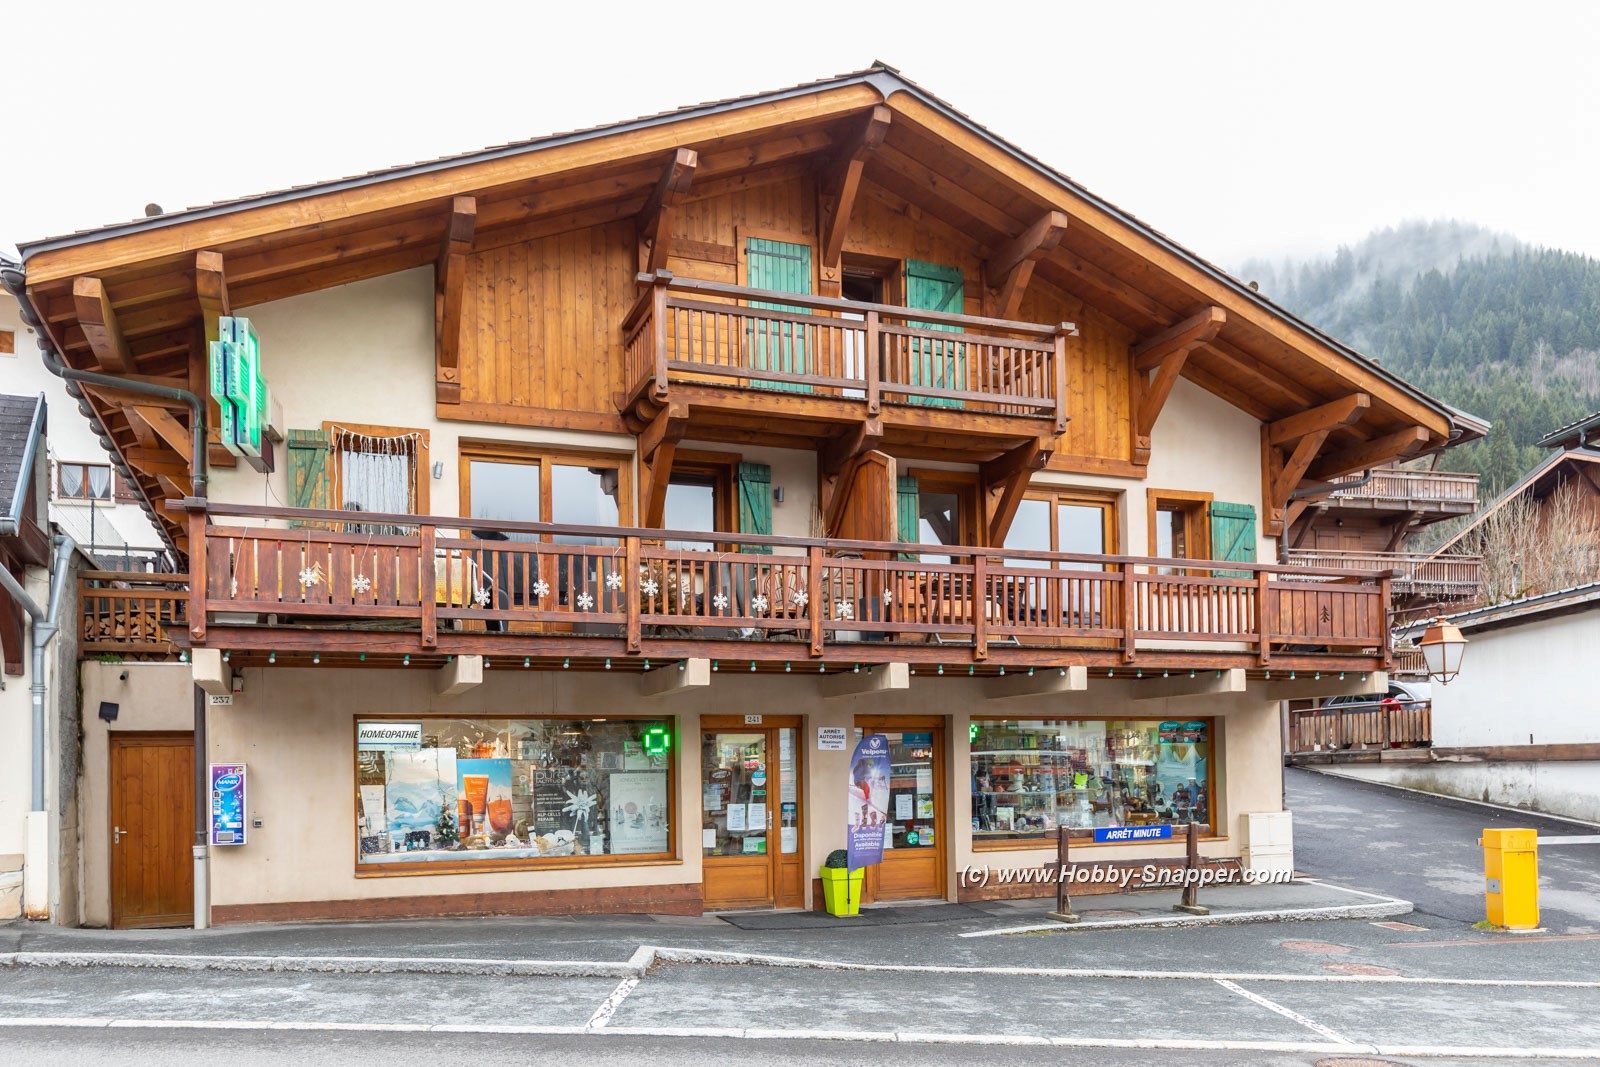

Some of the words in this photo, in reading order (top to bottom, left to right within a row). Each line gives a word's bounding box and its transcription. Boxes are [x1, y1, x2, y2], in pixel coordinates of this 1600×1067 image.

[212, 696, 230, 704] 237
[360, 729, 420, 739] HOMÉOPATHIE
[861, 748, 887, 756] Velpeau
[1105, 828, 1132, 839] ARRÊT
[1133, 828, 1161, 838] MINUTE
